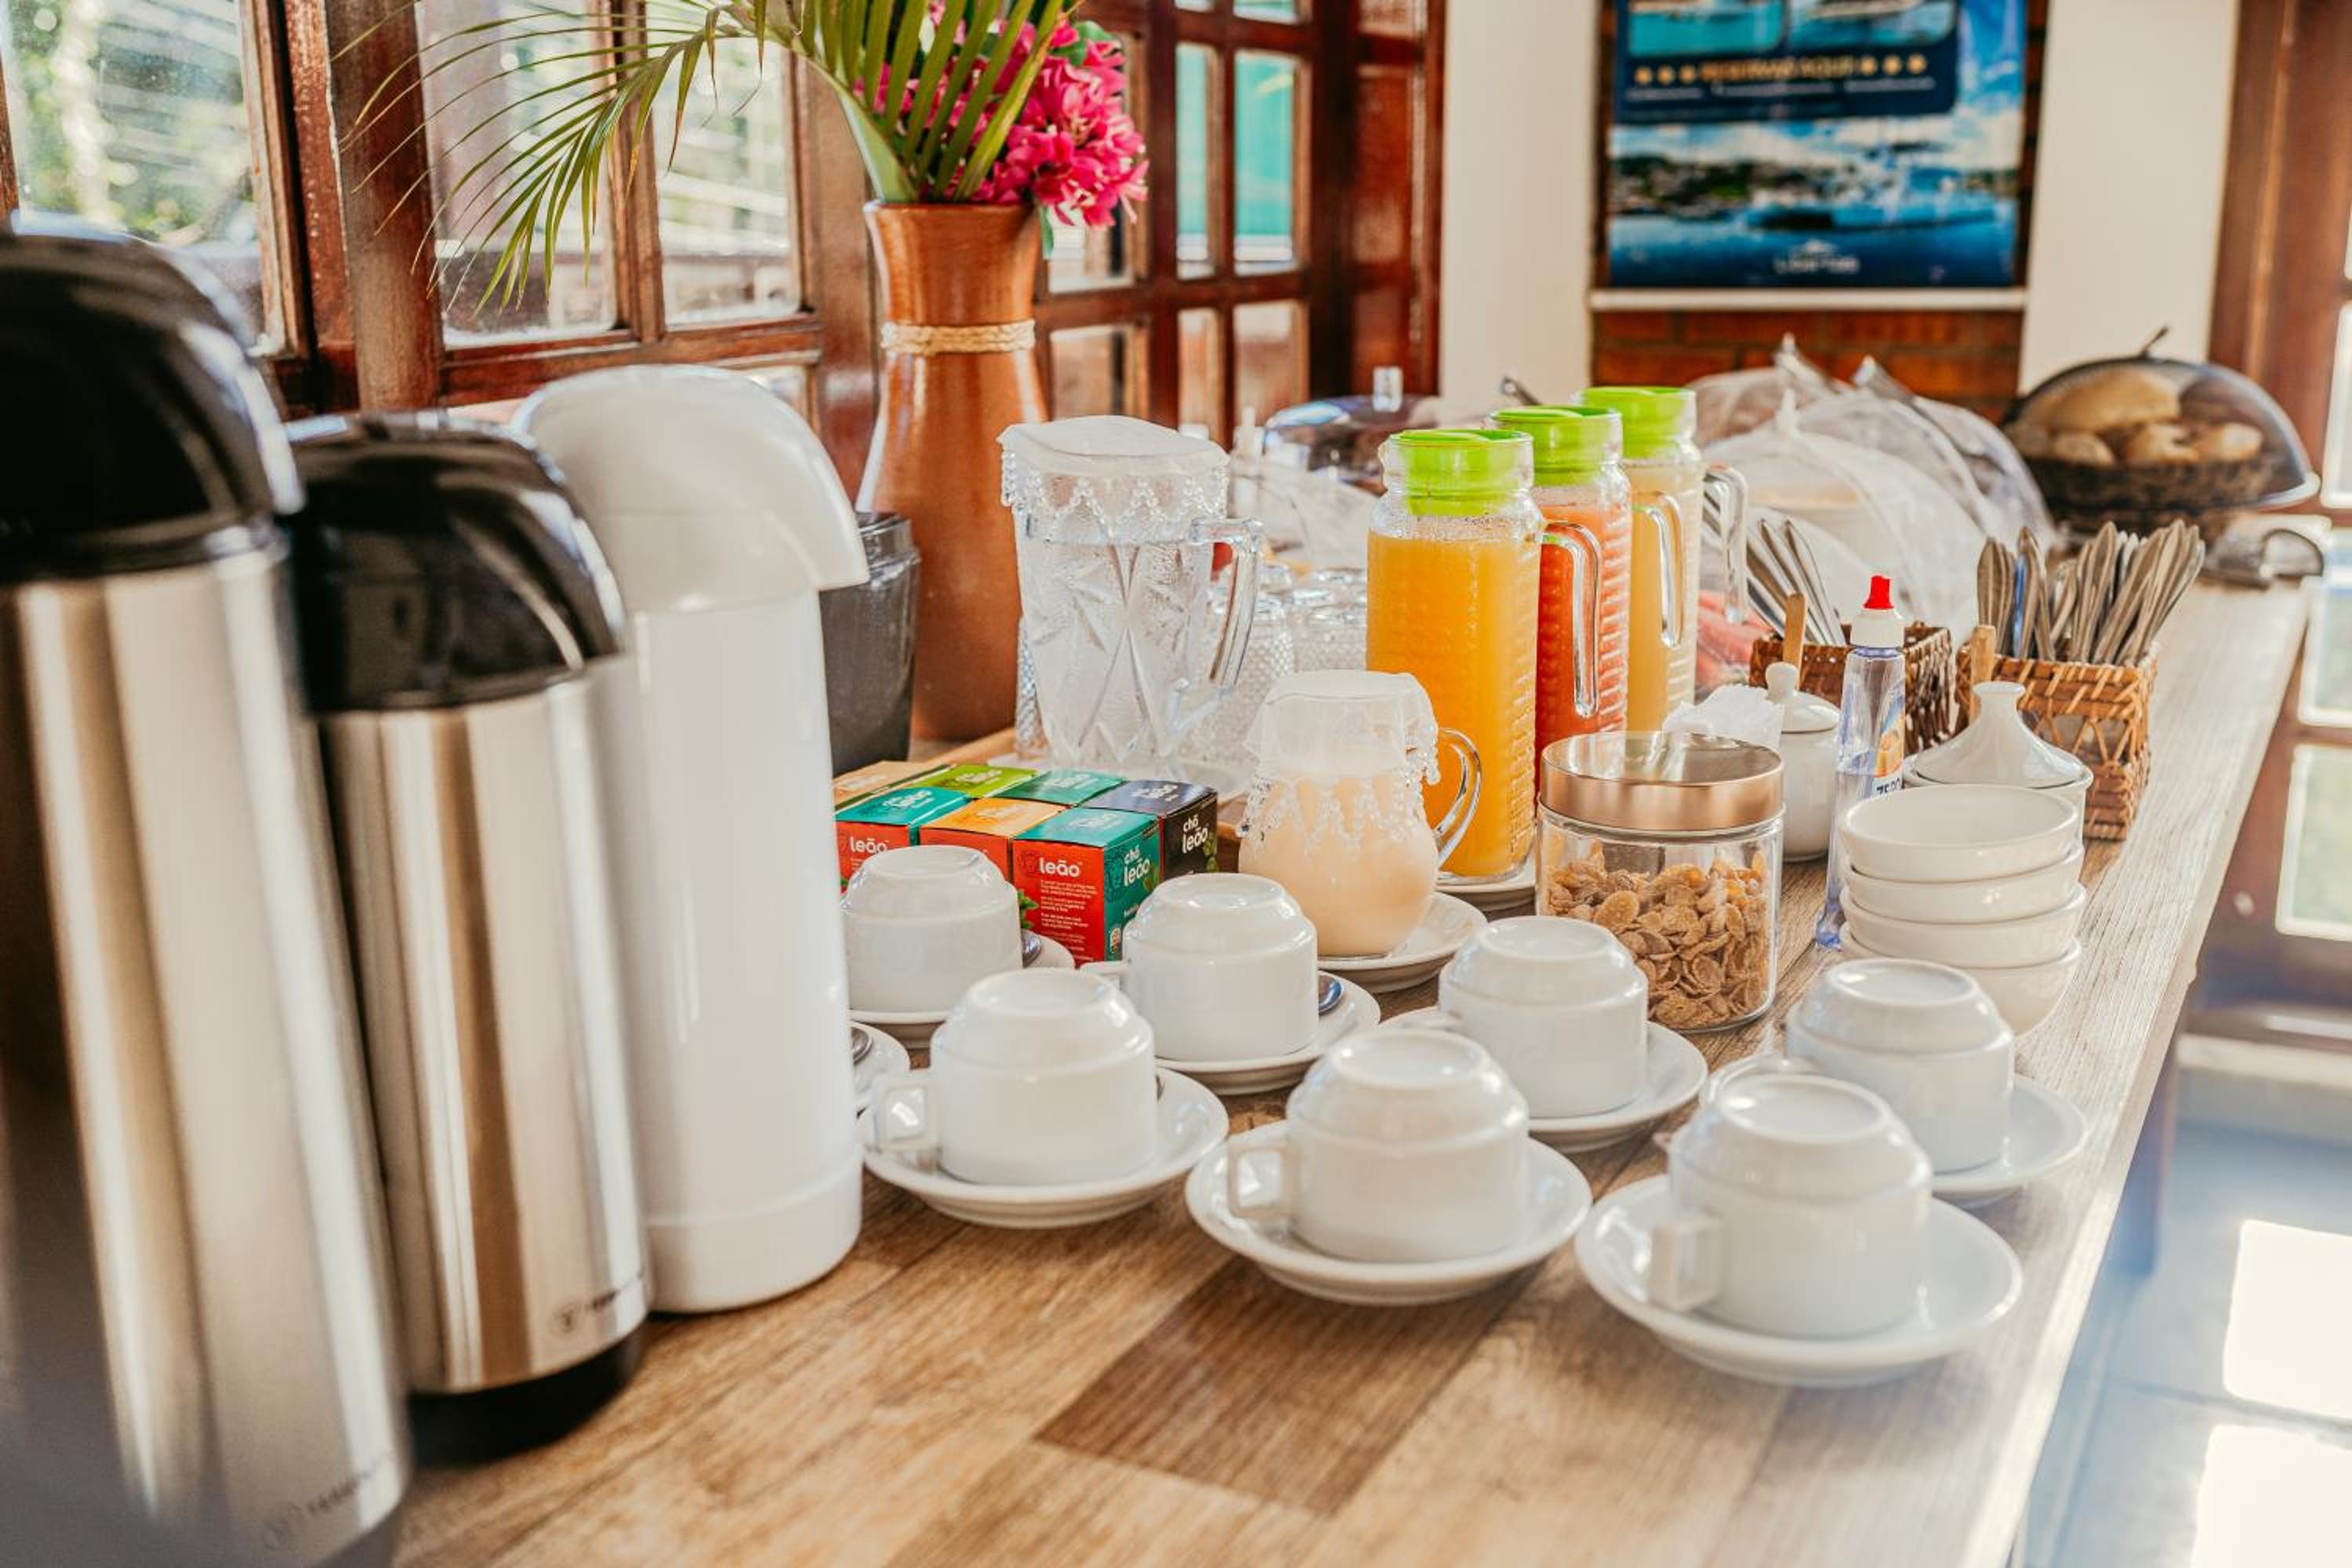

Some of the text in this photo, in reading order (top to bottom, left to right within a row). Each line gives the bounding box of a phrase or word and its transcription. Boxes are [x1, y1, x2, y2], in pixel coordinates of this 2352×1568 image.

[849, 836, 888, 854] leão
[1181, 826, 1209, 854] leão
[1039, 857, 1080, 877] leão
[1123, 858, 1151, 887] leão
